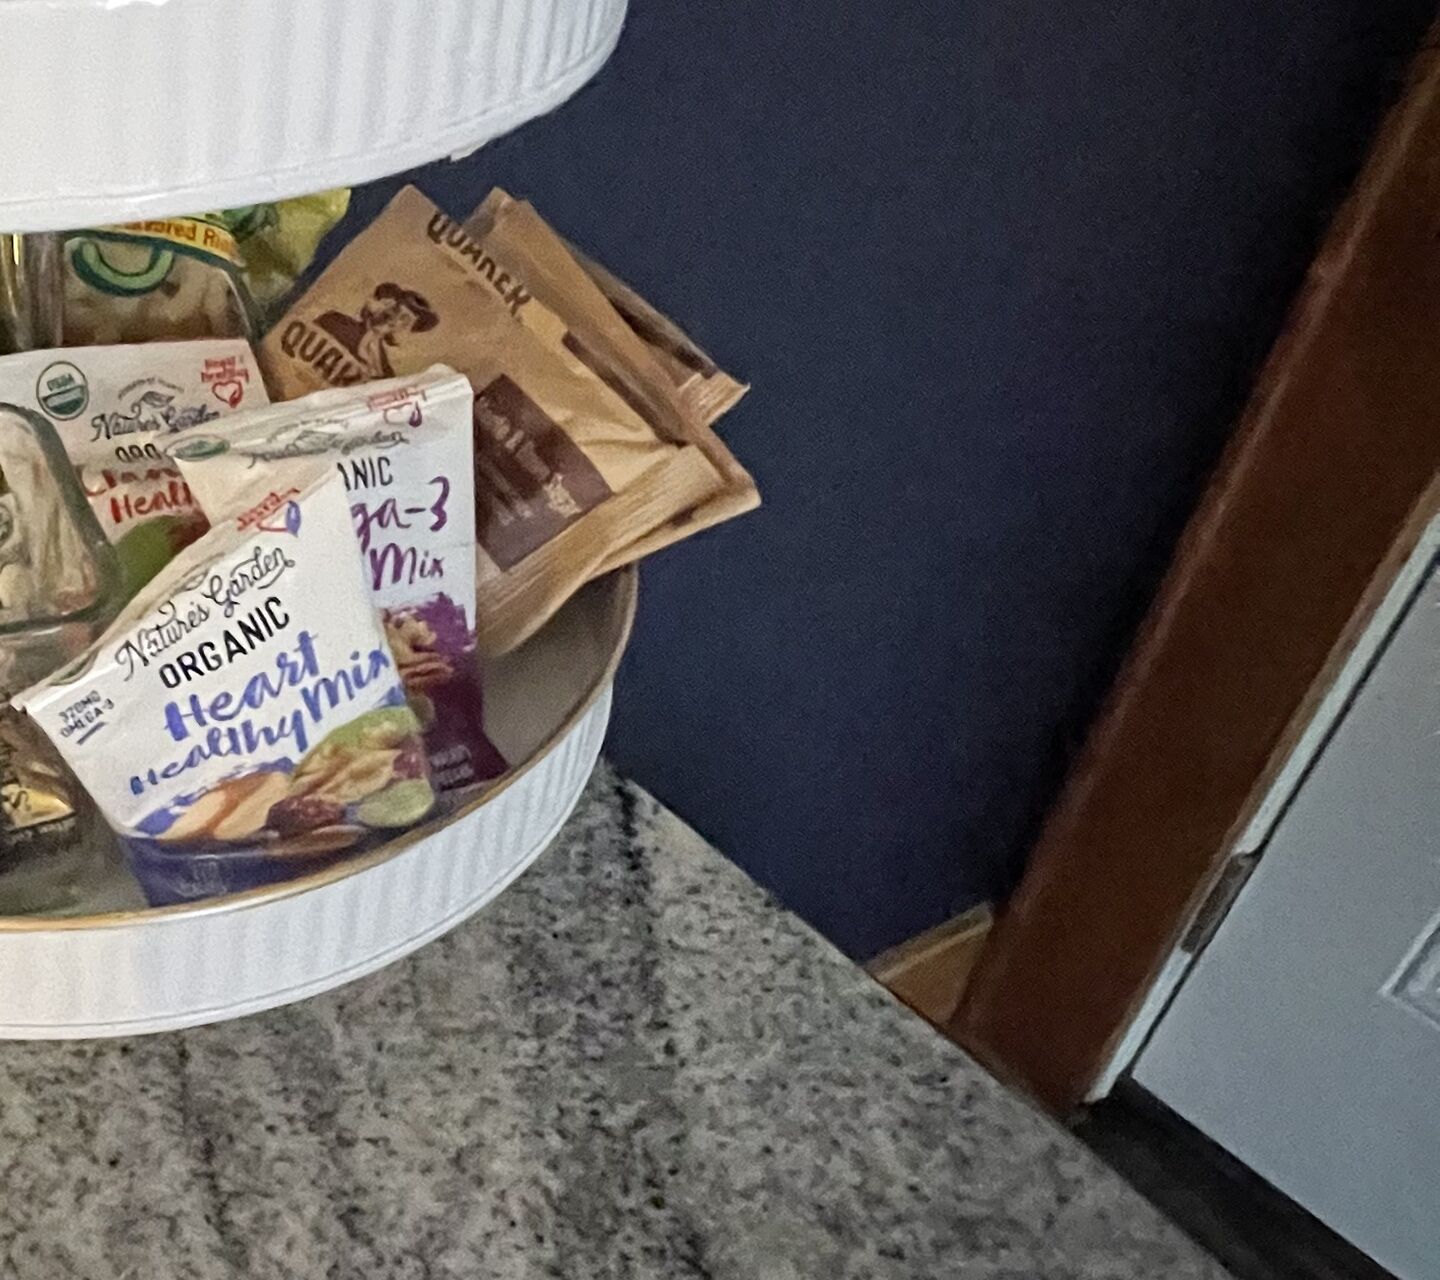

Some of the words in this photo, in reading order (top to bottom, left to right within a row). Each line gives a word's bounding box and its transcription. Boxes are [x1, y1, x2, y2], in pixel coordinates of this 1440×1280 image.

[200, 546, 297, 618] Garden
[369, 542, 445, 592] Mix
[159, 595, 291, 689] ORGANIC
[300, 642, 391, 723] Mix
[163, 630, 319, 742] Heart
